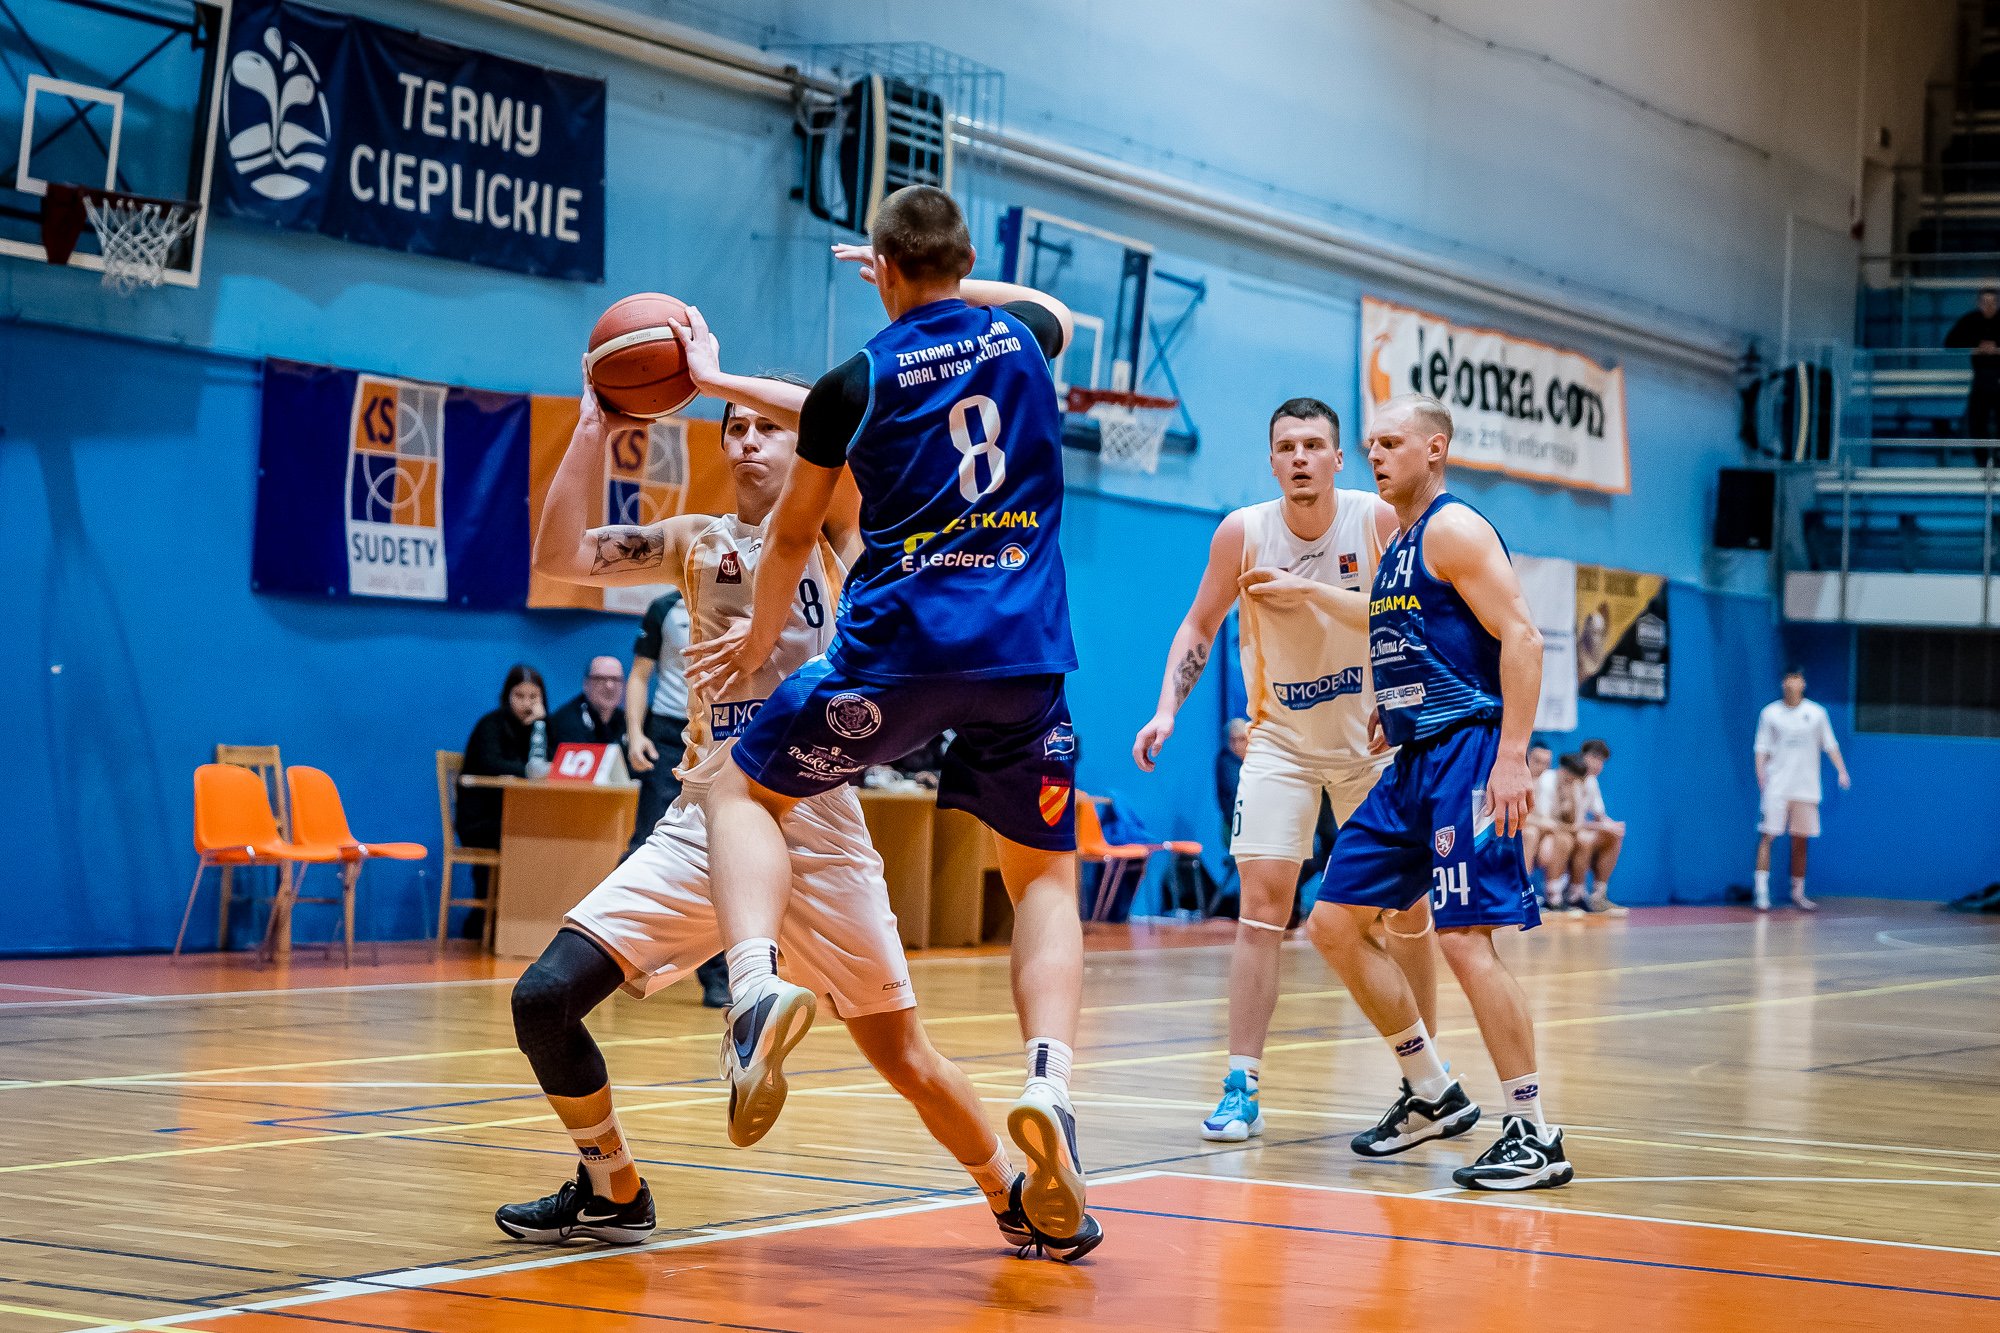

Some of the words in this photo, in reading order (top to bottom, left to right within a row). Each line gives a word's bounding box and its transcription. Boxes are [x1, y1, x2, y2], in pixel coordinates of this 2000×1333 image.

[399, 73, 542, 158] TERMY
[350, 144, 583, 243] CIEPLICKIE
[896, 343, 955, 367] ZETKAMA
[957, 339, 974, 353] LA
[897, 366, 937, 388] DORAL
[940, 359, 972, 379] NYSA
[949, 394, 1006, 504] 8
[352, 532, 438, 567] SUDETY
[1387, 546, 1416, 589] 34
[798, 578, 825, 629] 8
[1291, 669, 1362, 701] MODERN
[787, 746, 831, 771] Polskie
[1433, 861, 1471, 911] 34
